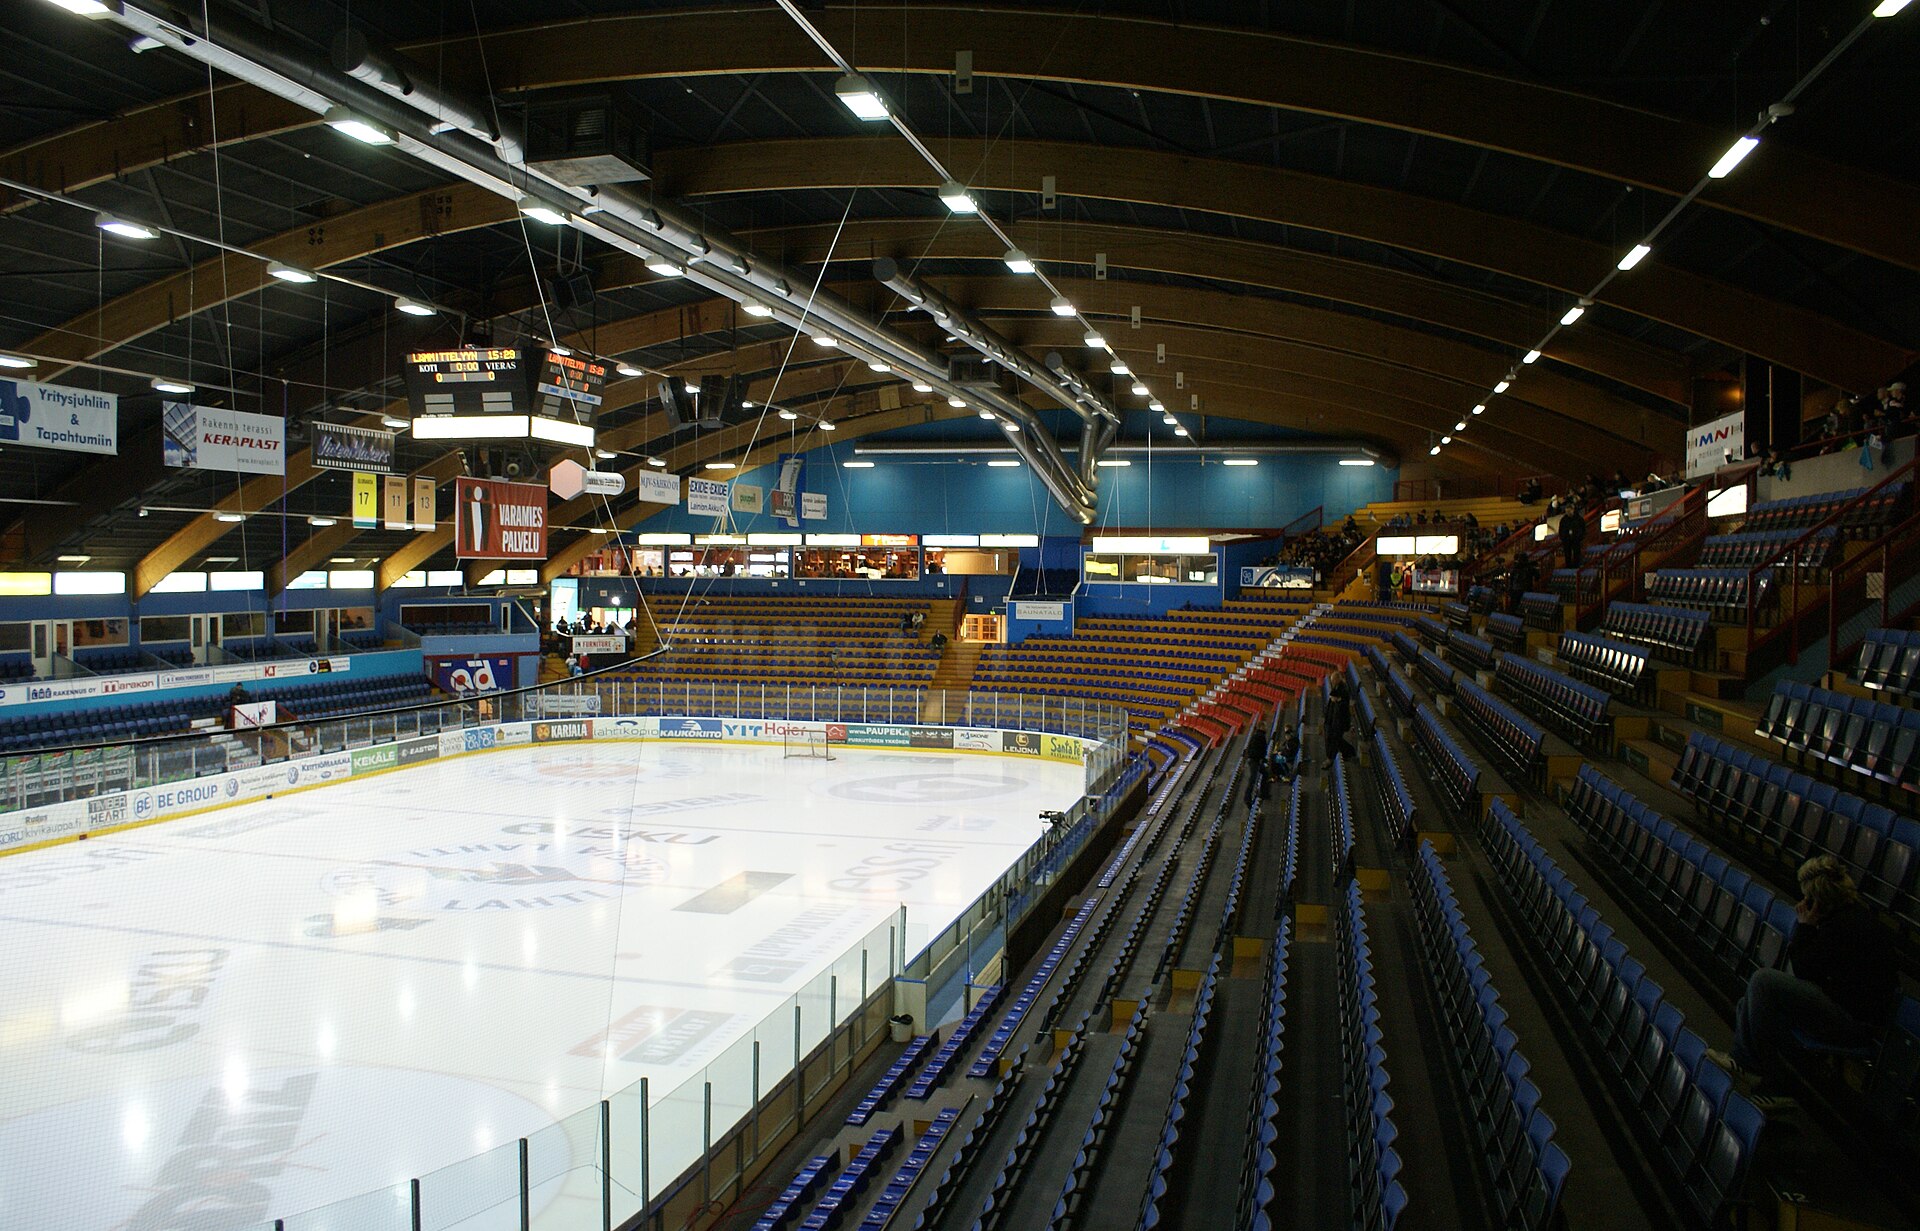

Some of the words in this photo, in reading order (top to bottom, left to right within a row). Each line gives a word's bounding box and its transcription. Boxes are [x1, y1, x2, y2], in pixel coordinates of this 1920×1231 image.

[488, 350, 515, 360] 15:29
[419, 364, 438, 372] KOTI
[456, 362, 478, 371] 0:00
[485, 361, 516, 370] VIERAS
[39, 388, 110, 409] Yritysjuhliin
[70, 413, 79, 425] &
[202, 417, 239, 431] Rakenna
[243, 423, 272, 435] terassi
[36, 427, 112, 447] Tapahtumiin
[203, 433, 280, 450] KERAPLAST
[690, 481, 708, 494] EXIDE
[709, 483, 727, 496] EXIDE
[358, 492, 369, 505] 17
[392, 495, 401, 506] 11
[421, 497, 430, 509] 13
[499, 504, 543, 528] VARAMIES
[502, 531, 540, 553] PALVELU
[583, 640, 611, 648] FURNITURE
[53, 688, 87, 697] RAKENNUS
[465, 731, 476, 741] Go
[481, 729, 492, 740] Go
[551, 723, 588, 738] KARJALA
[594, 726, 658, 737] lahtikopio
[660, 729, 722, 738] KAUKOKIITO
[724, 724, 762, 737] YIT
[764, 723, 807, 736] Haier
[410, 744, 437, 755] EASTON
[1004, 745, 1039, 755] LEIJONA
[1050, 737, 1072, 755] Santa
[353, 751, 394, 768] KEKÄLE
[158, 793, 174, 808] BE
[177, 785, 218, 805] GROUP
[88, 796, 127, 813] TIMBER
[136, 798, 151, 814] BE
[91, 809, 126, 824] HEART
[25, 819, 82, 838] kivikauppa.fi
[567, 826, 721, 846] ISKU
[443, 889, 608, 911] LAHTI
